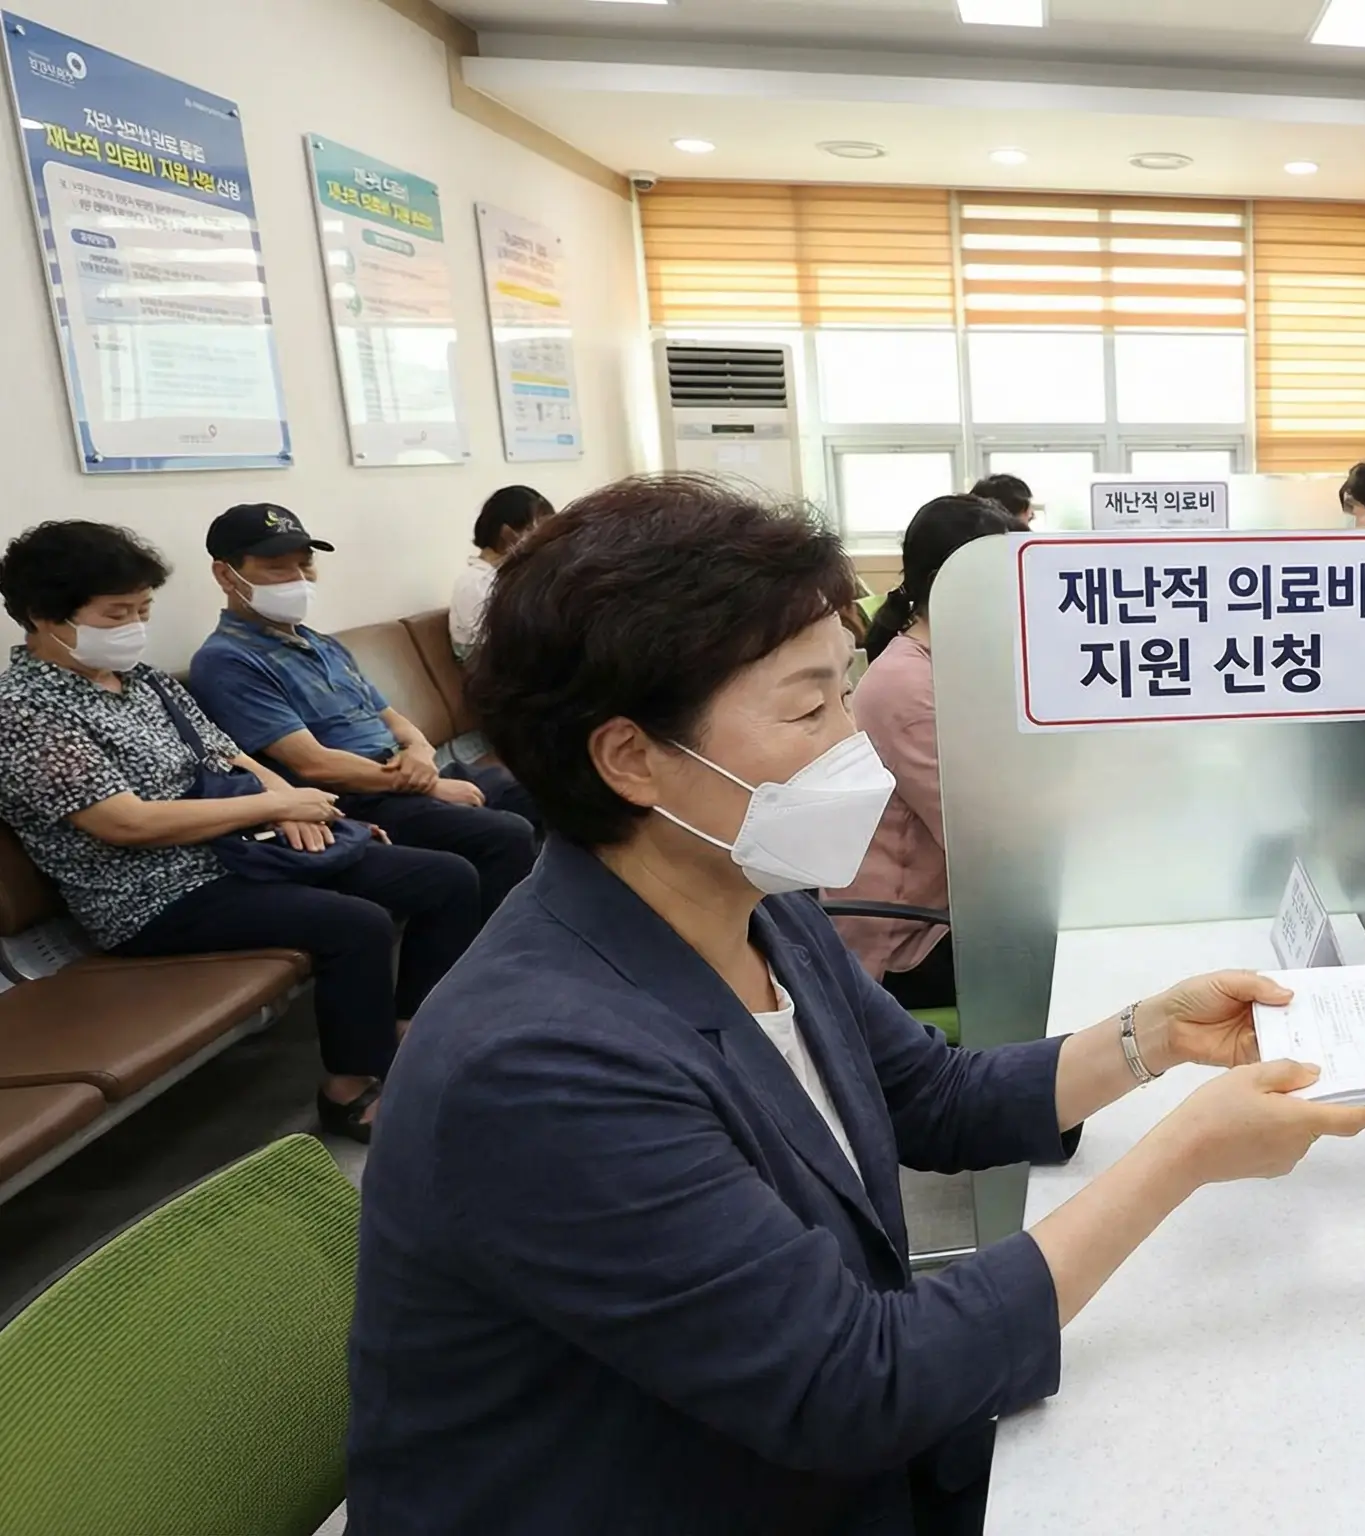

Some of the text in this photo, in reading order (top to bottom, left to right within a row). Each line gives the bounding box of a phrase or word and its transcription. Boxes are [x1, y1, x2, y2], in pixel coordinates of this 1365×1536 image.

[44, 123, 102, 162] 재난적
[106, 141, 156, 177] 의료비
[1105, 490, 1215, 514] 재난적 의료비
[1058, 565, 1208, 625] 재난적
[1080, 633, 1322, 698] 지원 신청
